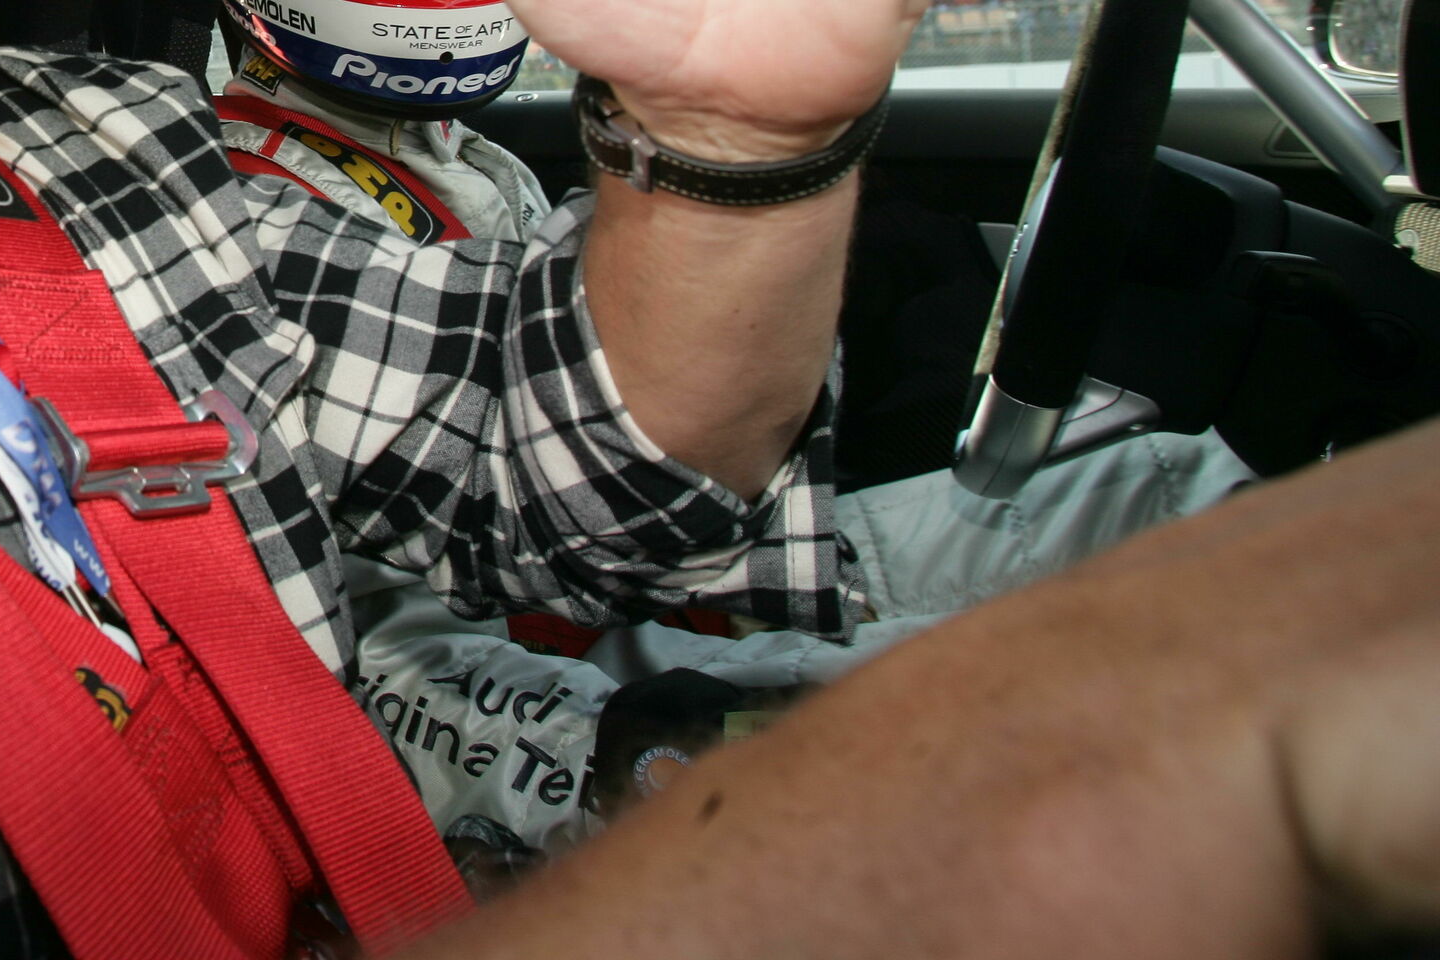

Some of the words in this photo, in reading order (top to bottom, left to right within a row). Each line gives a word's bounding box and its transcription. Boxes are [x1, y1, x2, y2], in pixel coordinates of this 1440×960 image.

[371, 22, 451, 40] STATE
[454, 25, 473, 39] OF
[478, 17, 515, 40] ART
[409, 38, 484, 50] MENSWEAR
[299, 132, 417, 238] OMP
[426, 666, 574, 725] Audi
